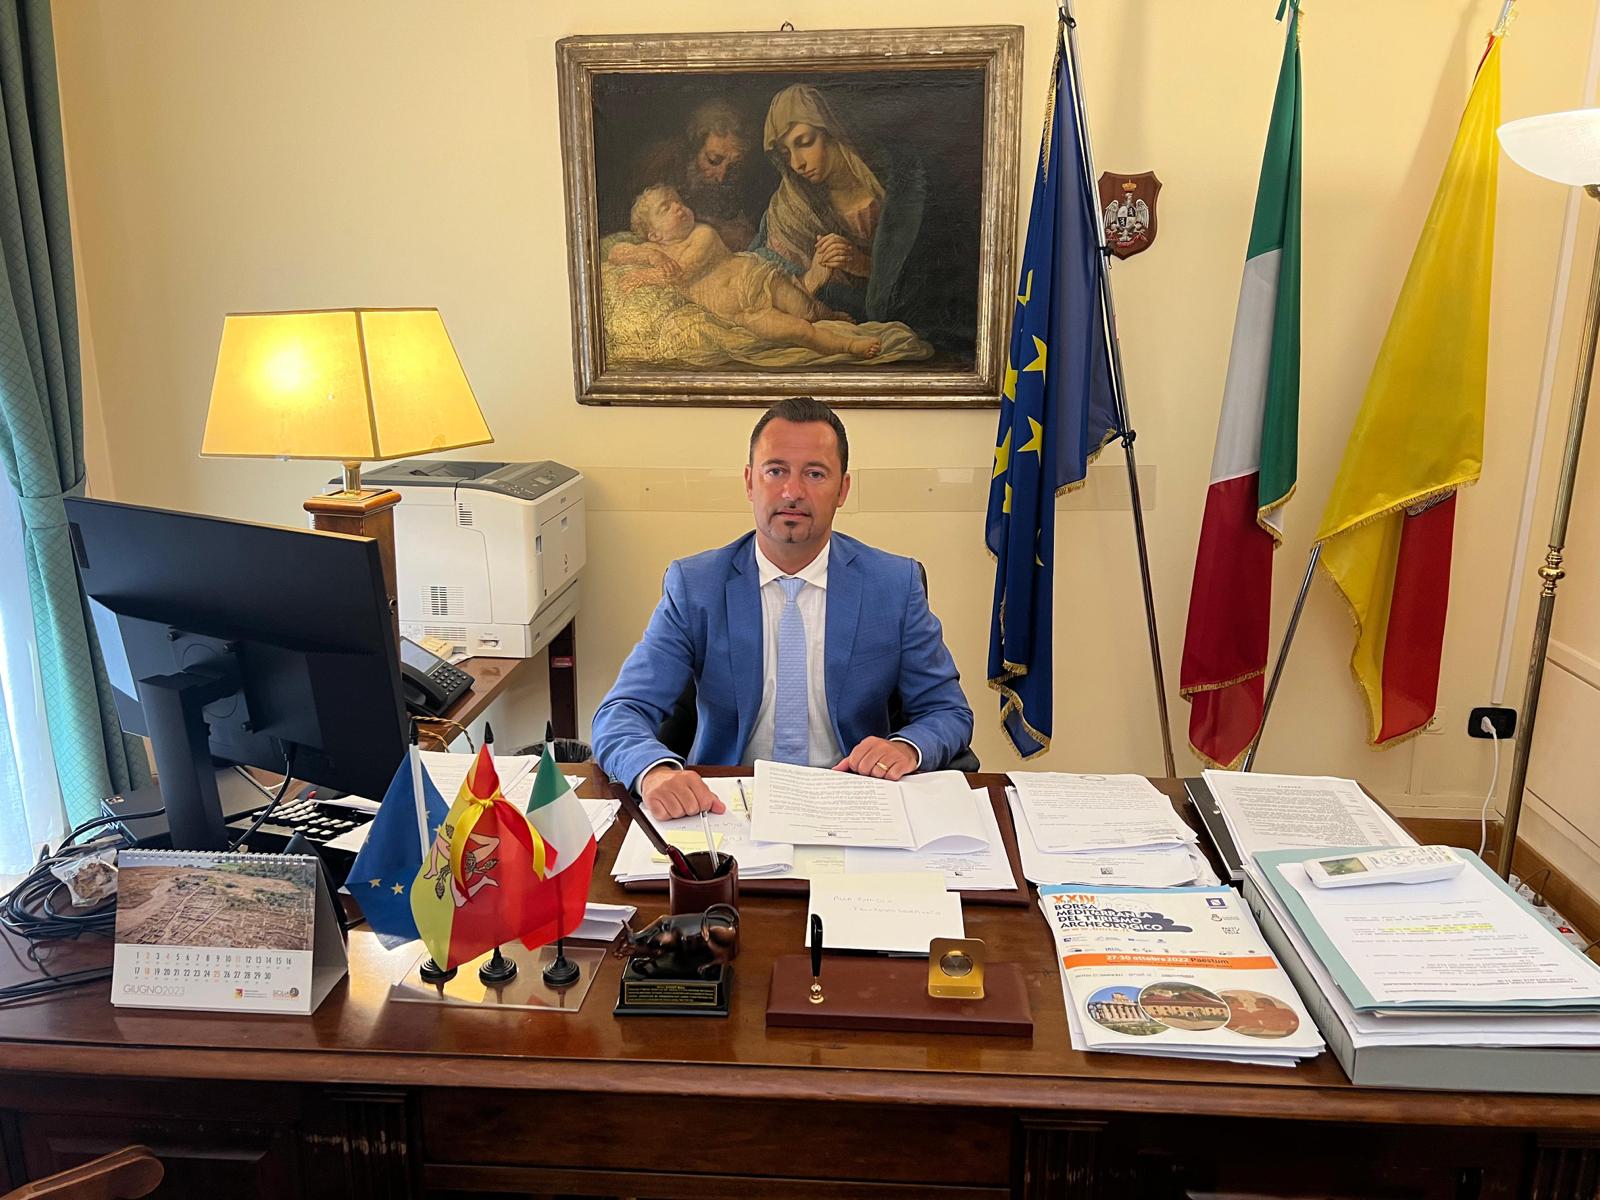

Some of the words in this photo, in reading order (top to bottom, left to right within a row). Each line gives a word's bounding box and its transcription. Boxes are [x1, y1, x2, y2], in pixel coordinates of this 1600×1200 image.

[1052, 895, 1096, 904] XXIV
[1054, 903, 1097, 911] BORSA
[1056, 908, 1152, 919] MEDITERRANEA
[1058, 915, 1082, 923] DEL
[1084, 915, 1143, 924] TURISMO
[1060, 921, 1163, 931] ARCHEOLOGICO
[256, 956, 262, 964] 13
[266, 956, 272, 964] 14
[276, 957, 282, 965] 15
[286, 957, 292, 965] 16
[134, 967, 140, 975] 17
[204, 970, 210, 978] 24
[254, 972, 261, 980] 29
[264, 972, 272, 980] 30
